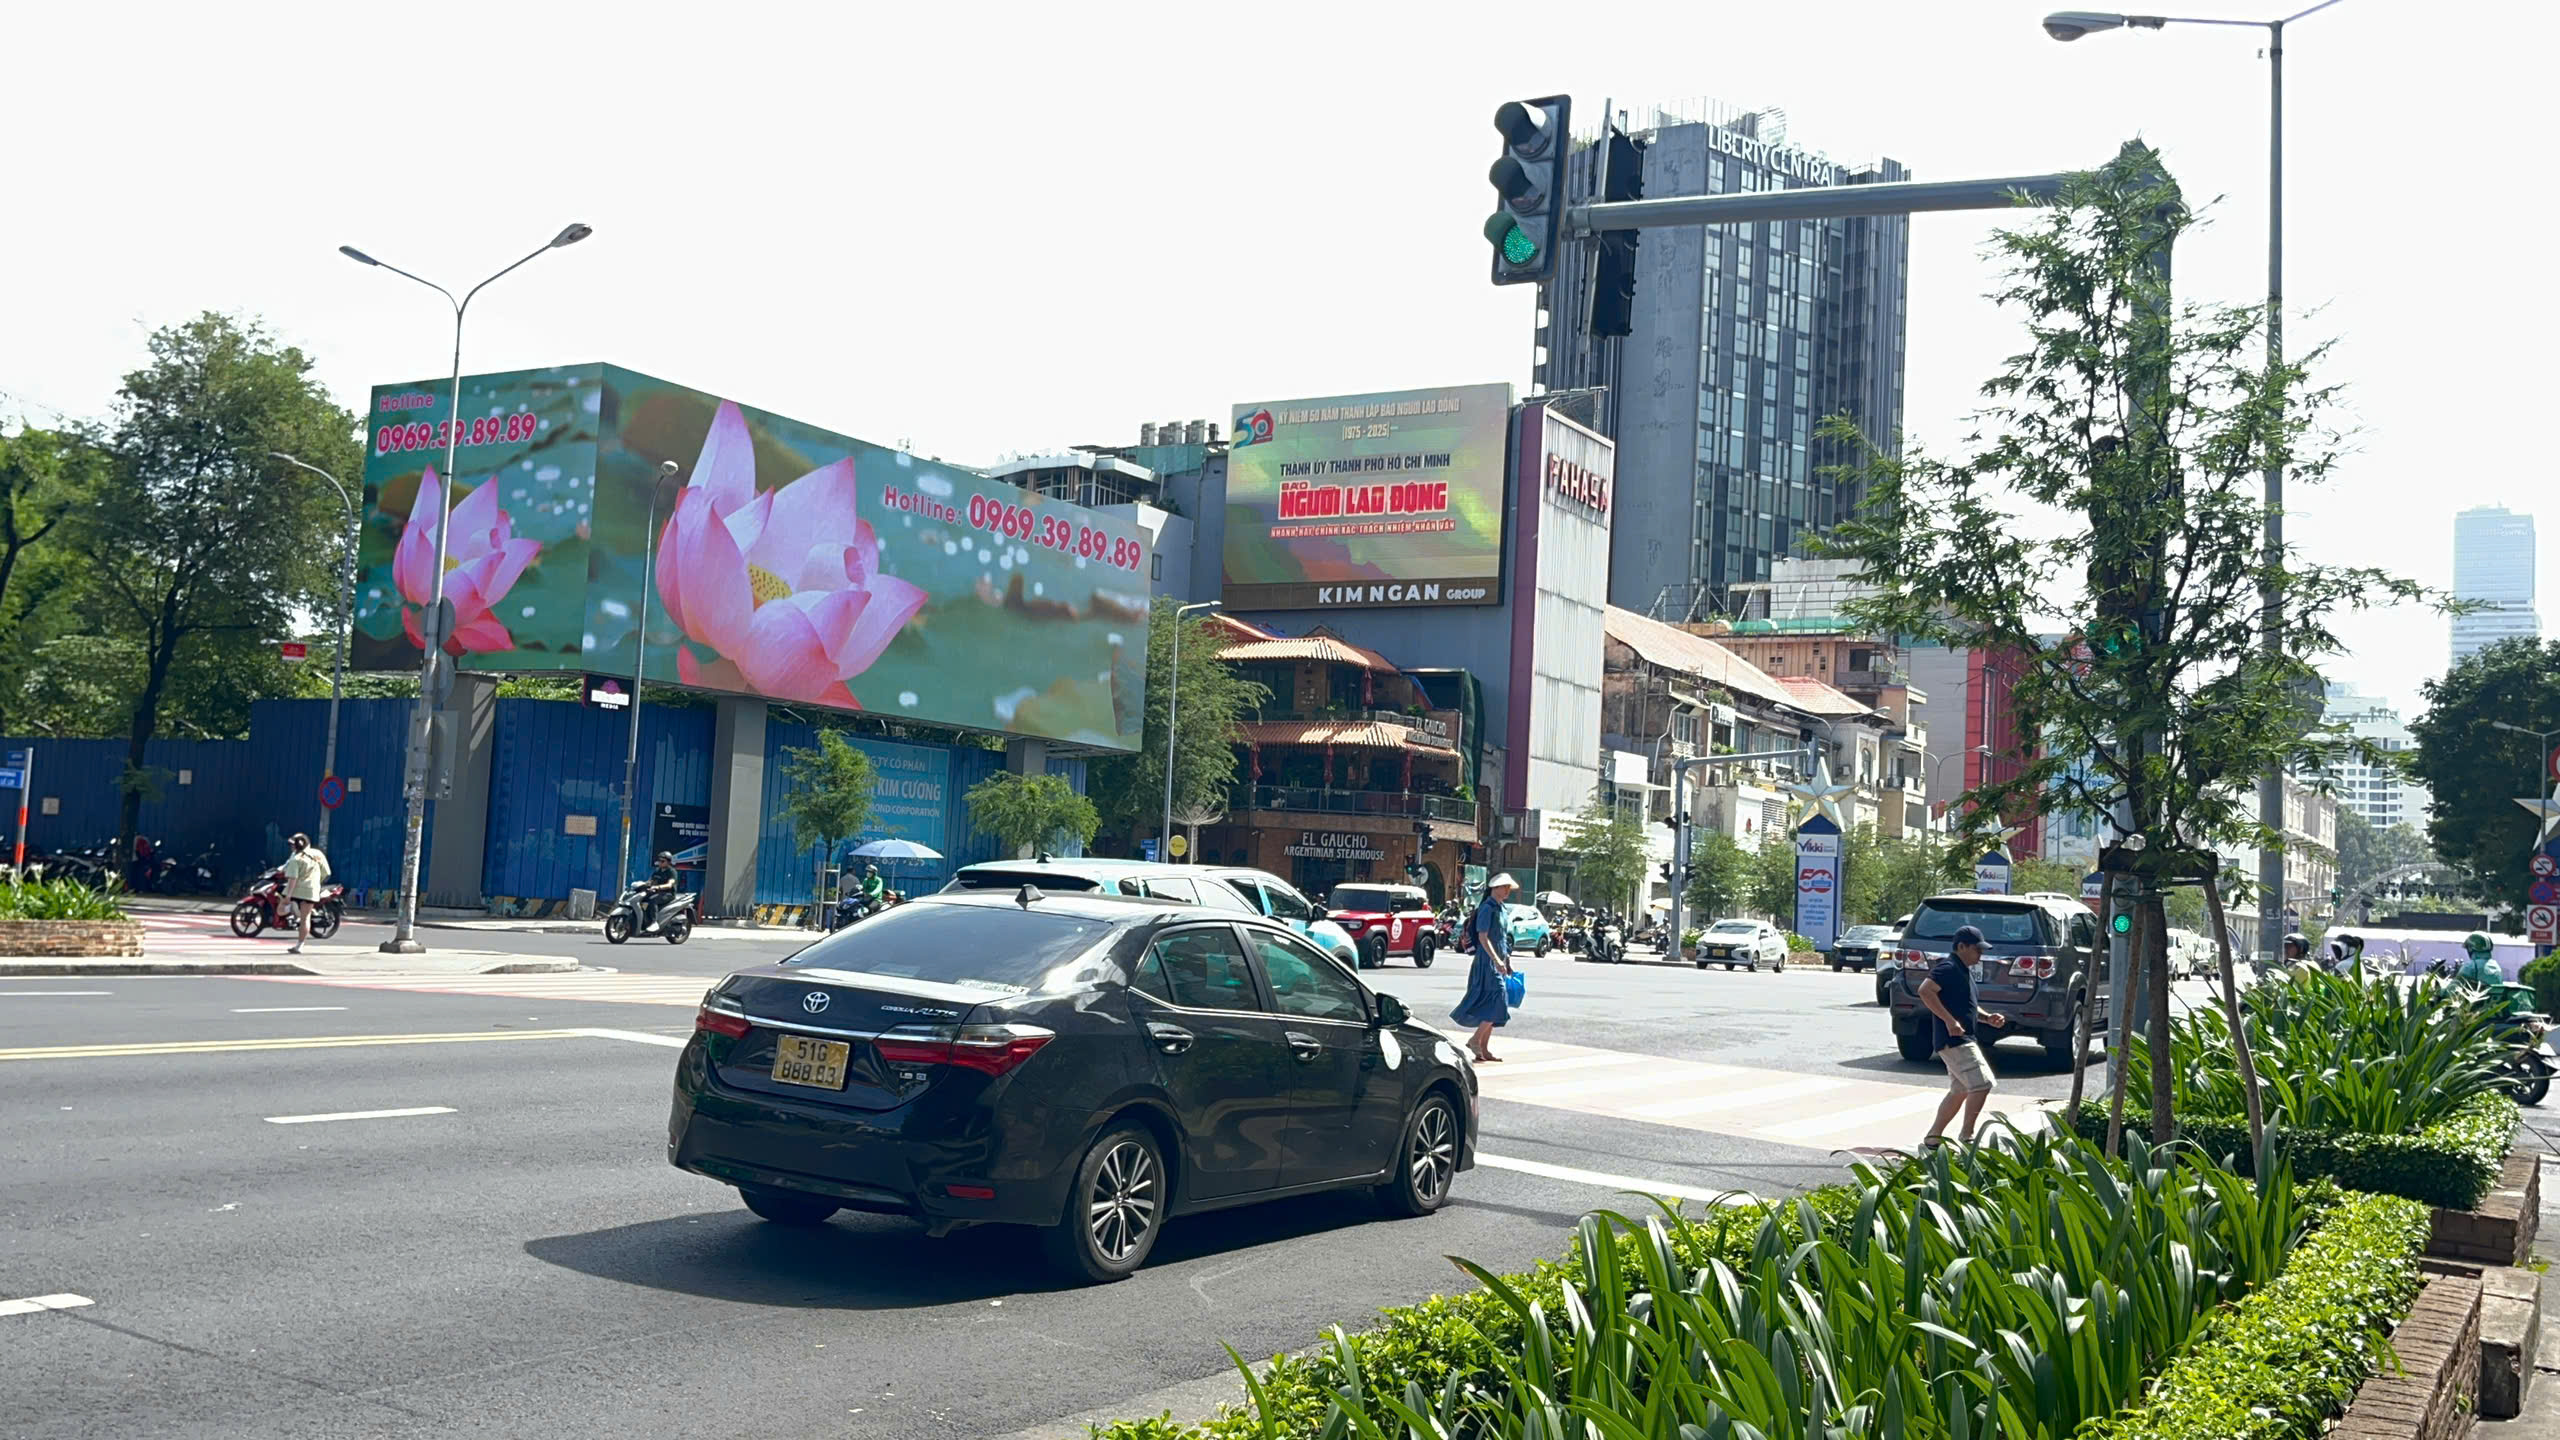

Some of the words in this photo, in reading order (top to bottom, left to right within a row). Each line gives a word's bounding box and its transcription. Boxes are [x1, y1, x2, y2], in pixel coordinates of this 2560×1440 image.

[1708, 124, 1769, 166] LIBERTY
[1770, 145, 1835, 187] CENTRAL
[379, 393, 434, 412] Hotline
[1289, 408, 1308, 427] NIỆM
[1309, 409, 1320, 423] 50
[1321, 405, 1339, 421] NĂM
[1341, 404, 1365, 420] THÀNH
[1366, 402, 1379, 421] LẬP
[1380, 401, 1396, 417] BÁO
[1397, 400, 1420, 416] NGƯỜI
[1422, 399, 1436, 414] LAO
[1438, 398, 1460, 416] ĐỘNG
[377, 413, 537, 454] 0969.39.89.89
[1280, 461, 1311, 477] THÀNH
[1330, 458, 1361, 474] THÀNH
[1364, 456, 1384, 471] PHỐ
[1387, 454, 1401, 470] HỒ
[1404, 453, 1421, 469] CHÍ
[1424, 453, 1450, 468] MINH
[1281, 481, 1308, 490] BÁO
[1546, 452, 1609, 512] FAHASA
[1279, 485, 1341, 519] NGƯỜI
[1345, 485, 1385, 516] LAO
[1388, 481, 1447, 515] ĐỘNG
[885, 484, 963, 526] Hotline:
[968, 494, 1142, 572] 0969.39.89.89
[1319, 587, 1363, 603] KIM
[1370, 584, 1440, 602] NGAN
[1446, 588, 1486, 600] GROUP
[877, 779, 899, 798] KIM
[901, 779, 941, 801] CƯƠNG
[891, 805, 940, 818] CORPORATION
[1302, 831, 1317, 846] EL
[1320, 832, 1369, 849] GAUCHO
[1797, 838, 1824, 853] Vikki
[1283, 845, 1334, 858] ARGENTINIAN
[1336, 848, 1385, 861] STEAKHOUSE
[796, 1041, 829, 1062] 51G
